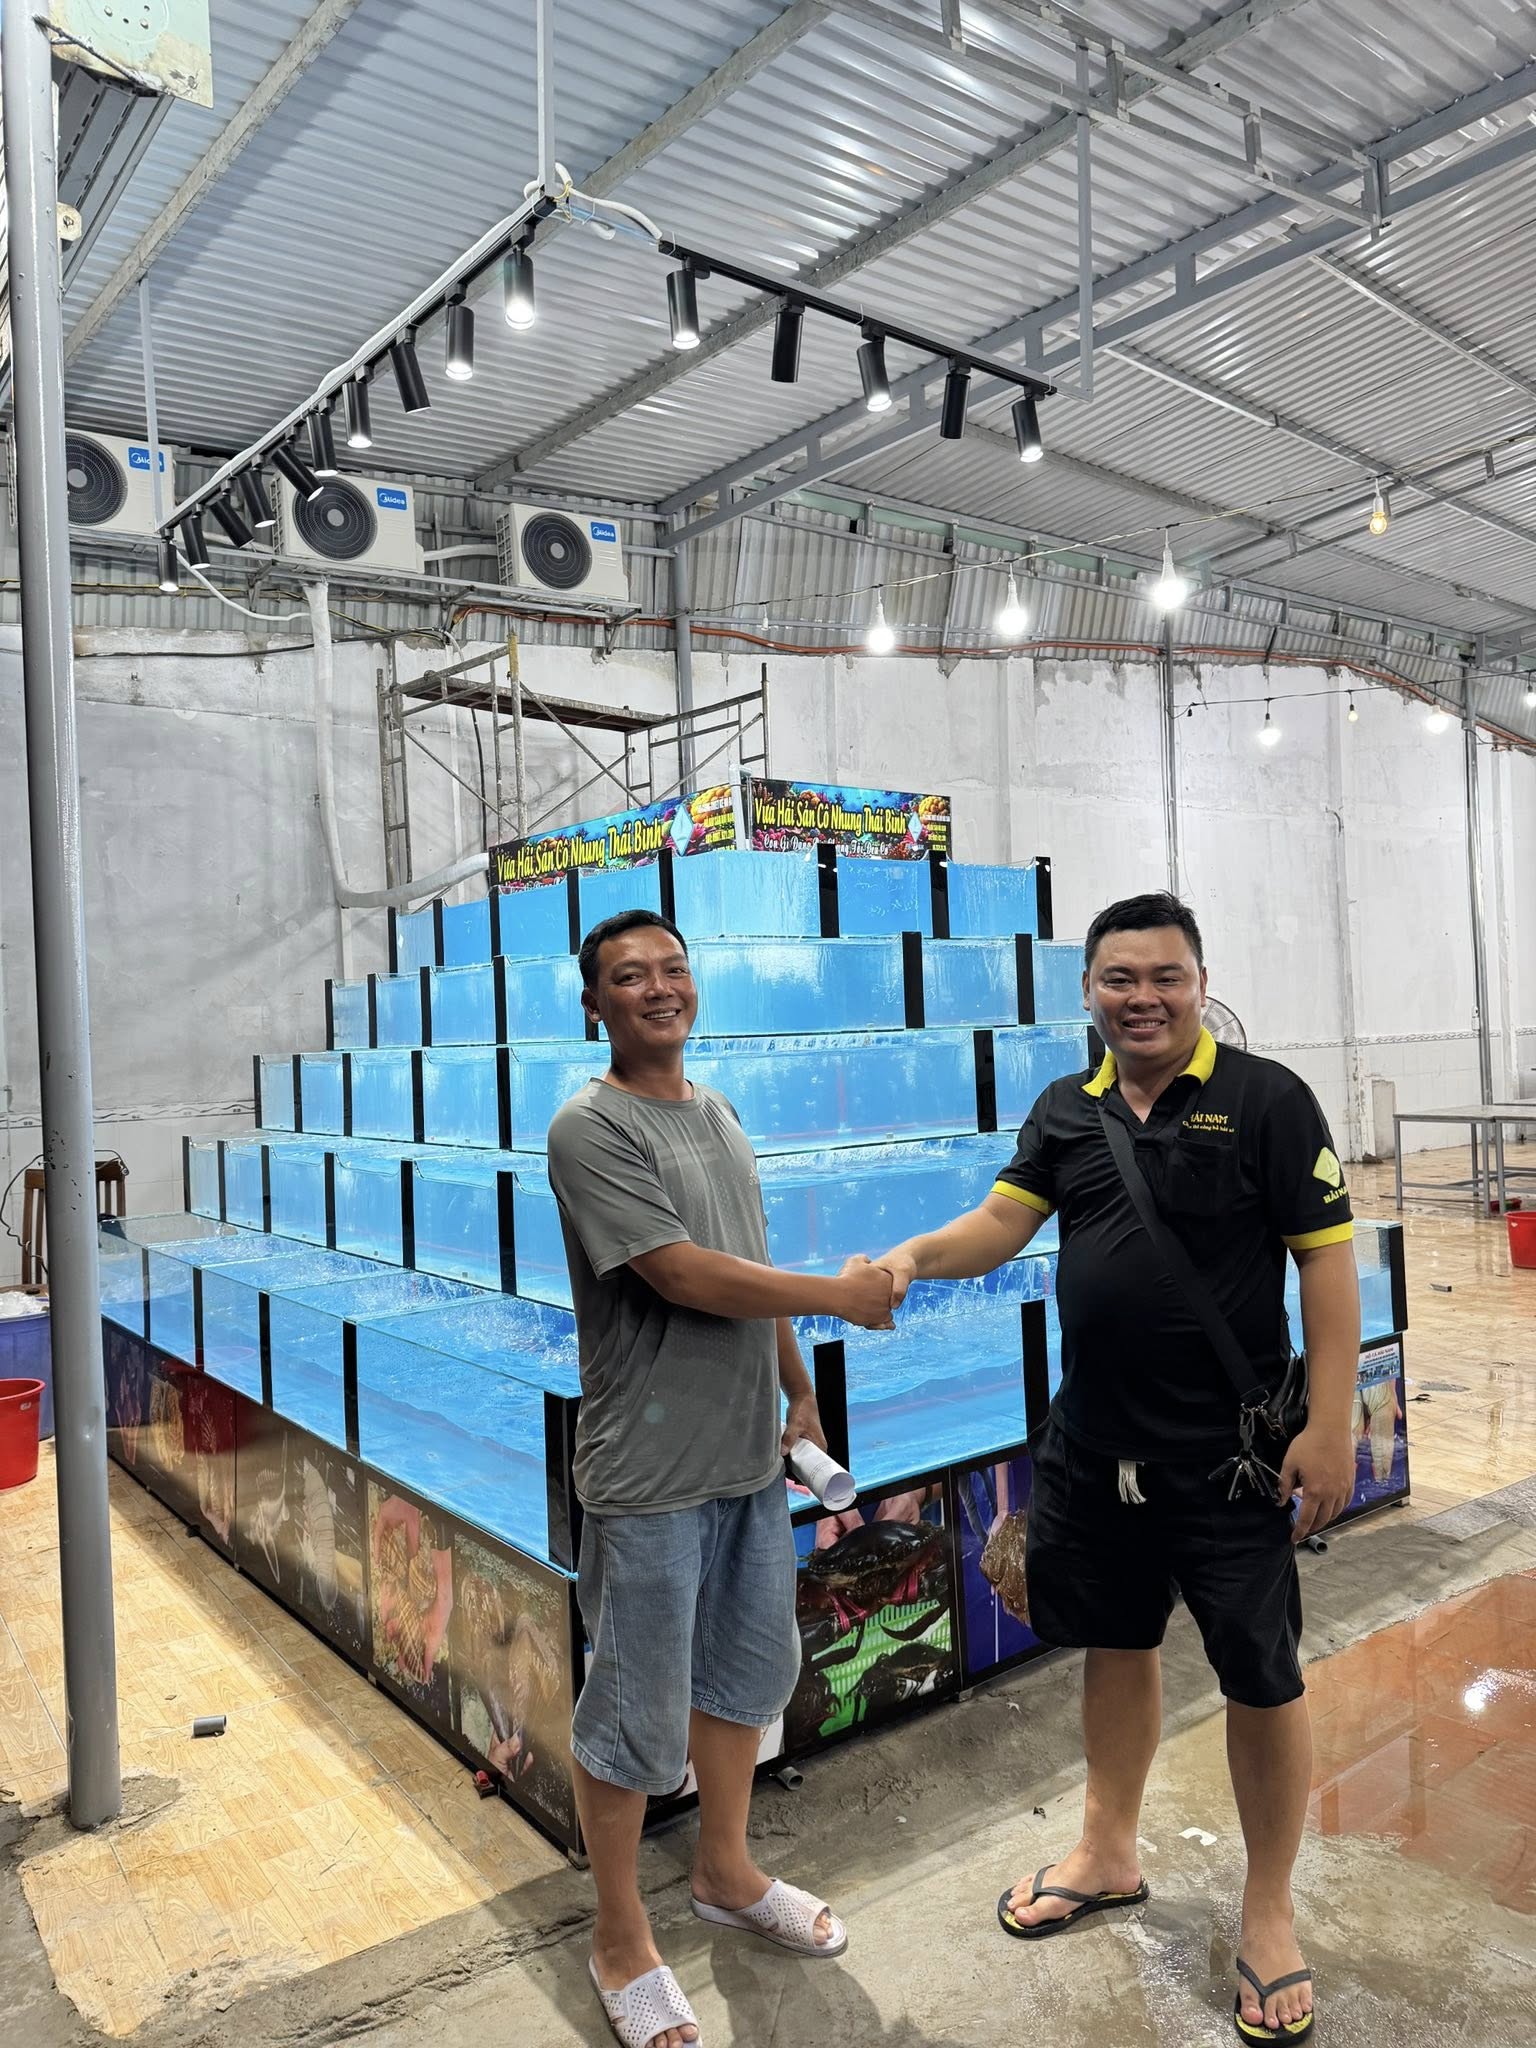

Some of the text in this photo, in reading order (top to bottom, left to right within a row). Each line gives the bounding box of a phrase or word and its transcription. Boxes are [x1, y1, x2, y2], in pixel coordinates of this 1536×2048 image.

[381, 494, 405, 505] Midea
[595, 528, 615, 537] Midea
[777, 797, 795, 827] Hải
[796, 800, 815, 828] Sản
[817, 802, 829, 829] Cô
[831, 804, 862, 837] Nhung
[863, 807, 883, 833] Thái
[885, 808, 906, 834] Bình
[517, 845, 534, 880] Hải
[535, 842, 555, 875] Sản
[556, 839, 569, 870] Cô
[570, 836, 605, 868] Nhung
[608, 822, 632, 859] Thái
[634, 818, 662, 853] Bình
[1205, 1113, 1229, 1124] NAM
[1322, 1190, 1339, 1204] HẢI
